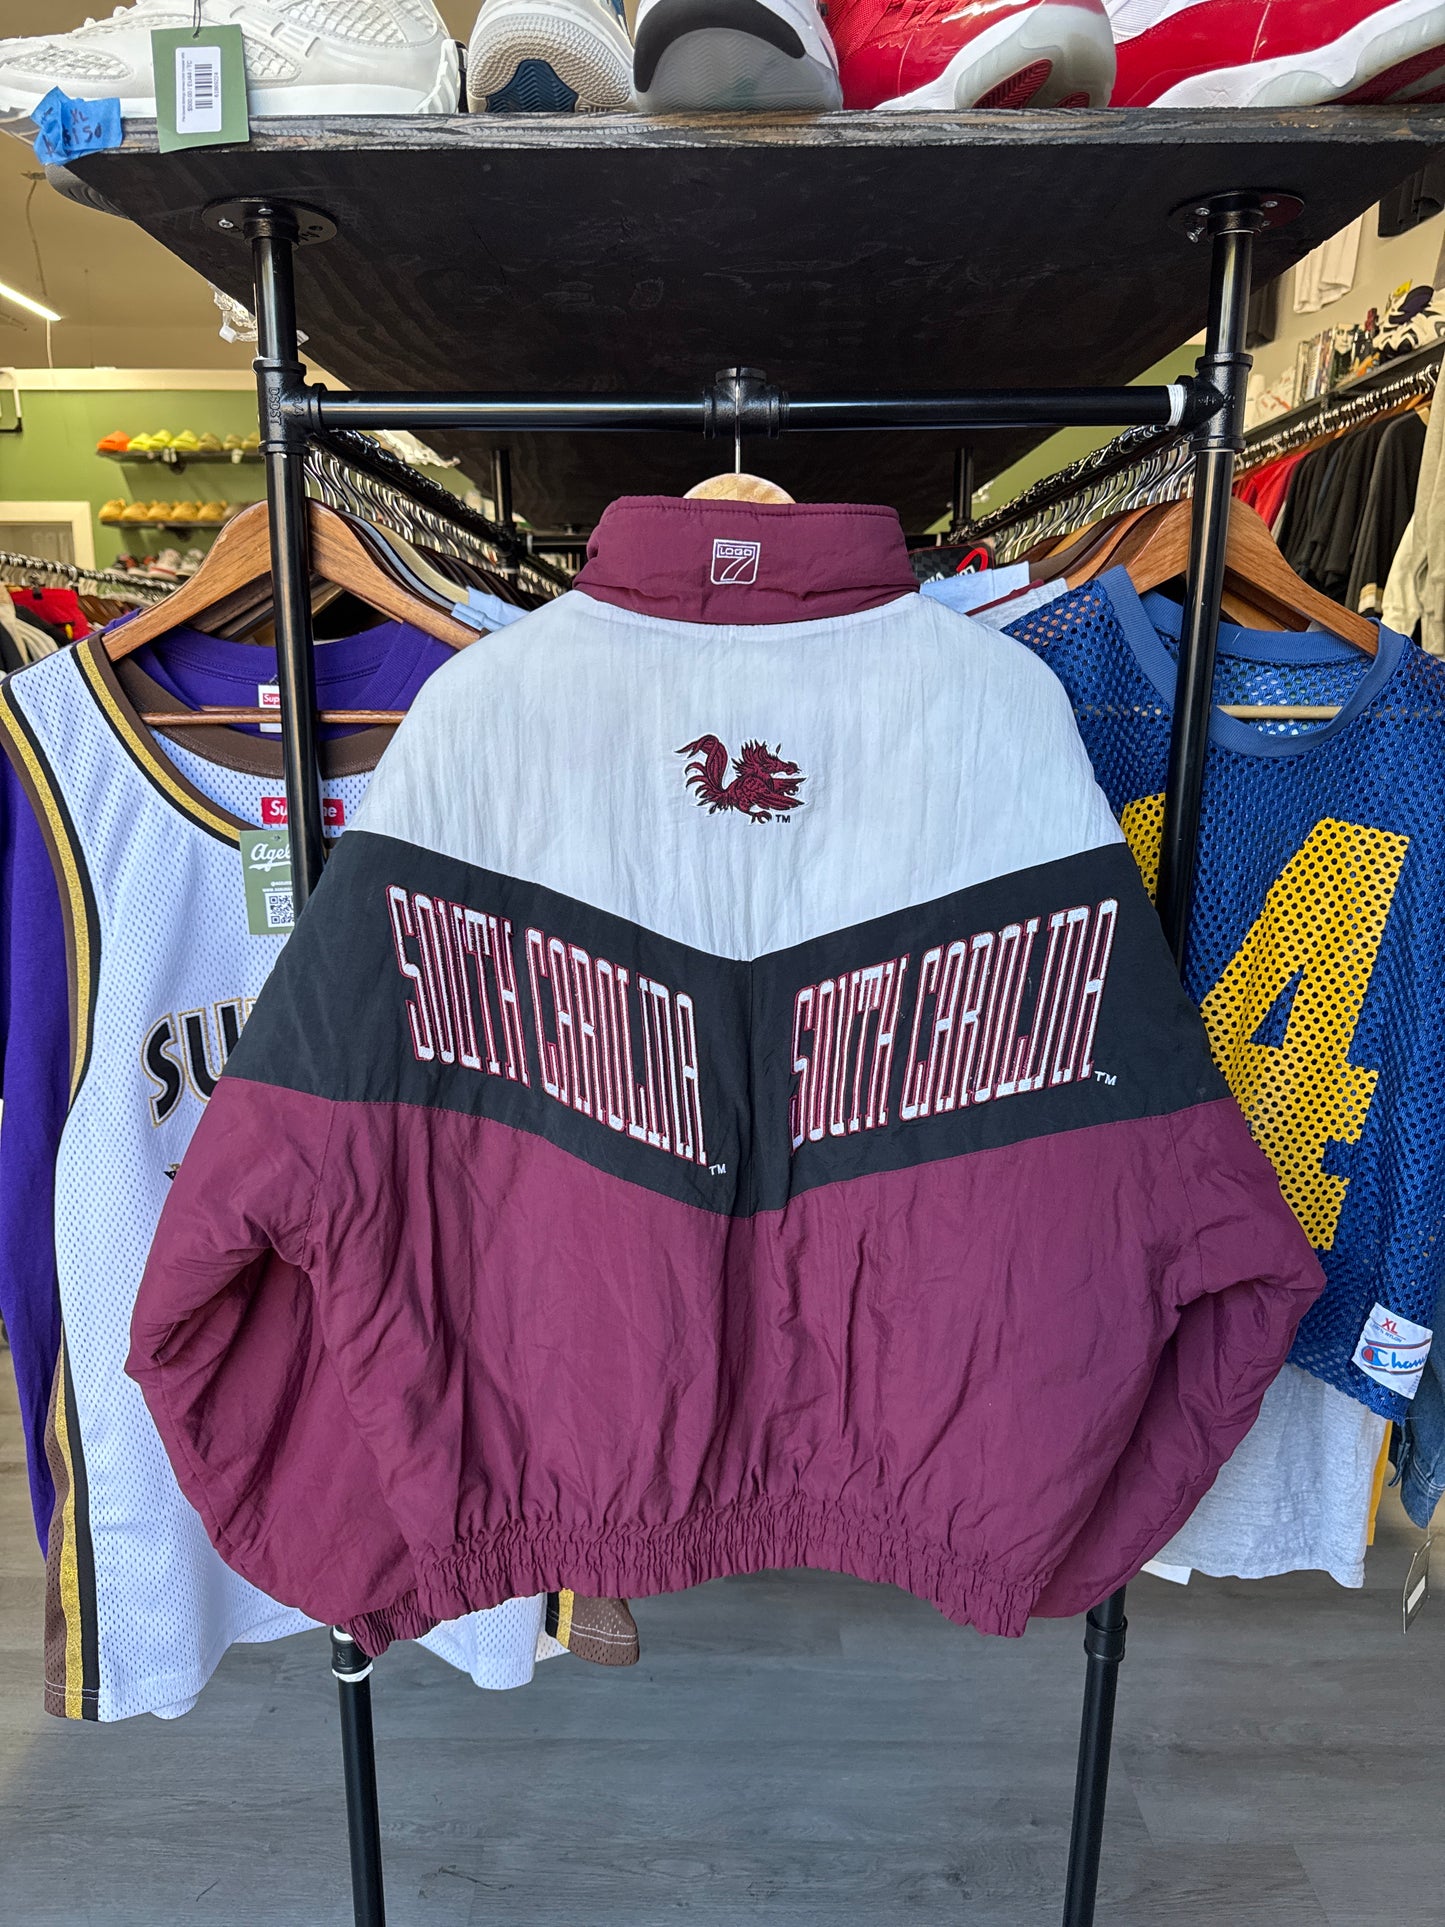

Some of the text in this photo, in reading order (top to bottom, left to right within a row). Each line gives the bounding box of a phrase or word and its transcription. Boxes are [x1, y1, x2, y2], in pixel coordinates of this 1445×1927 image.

[70, 107, 89, 125] XL
[720, 547, 753, 556] LOGO
[775, 814, 791, 823] TM
[140, 997, 257, 1128] SU
[385, 884, 727, 1176] SOUTH CAROLINA TM
[789, 898, 1118, 1155] SOUTH CAROLINA TM
[1200, 816, 1411, 1251] 4
[1381, 1317, 1398, 1335] XL
